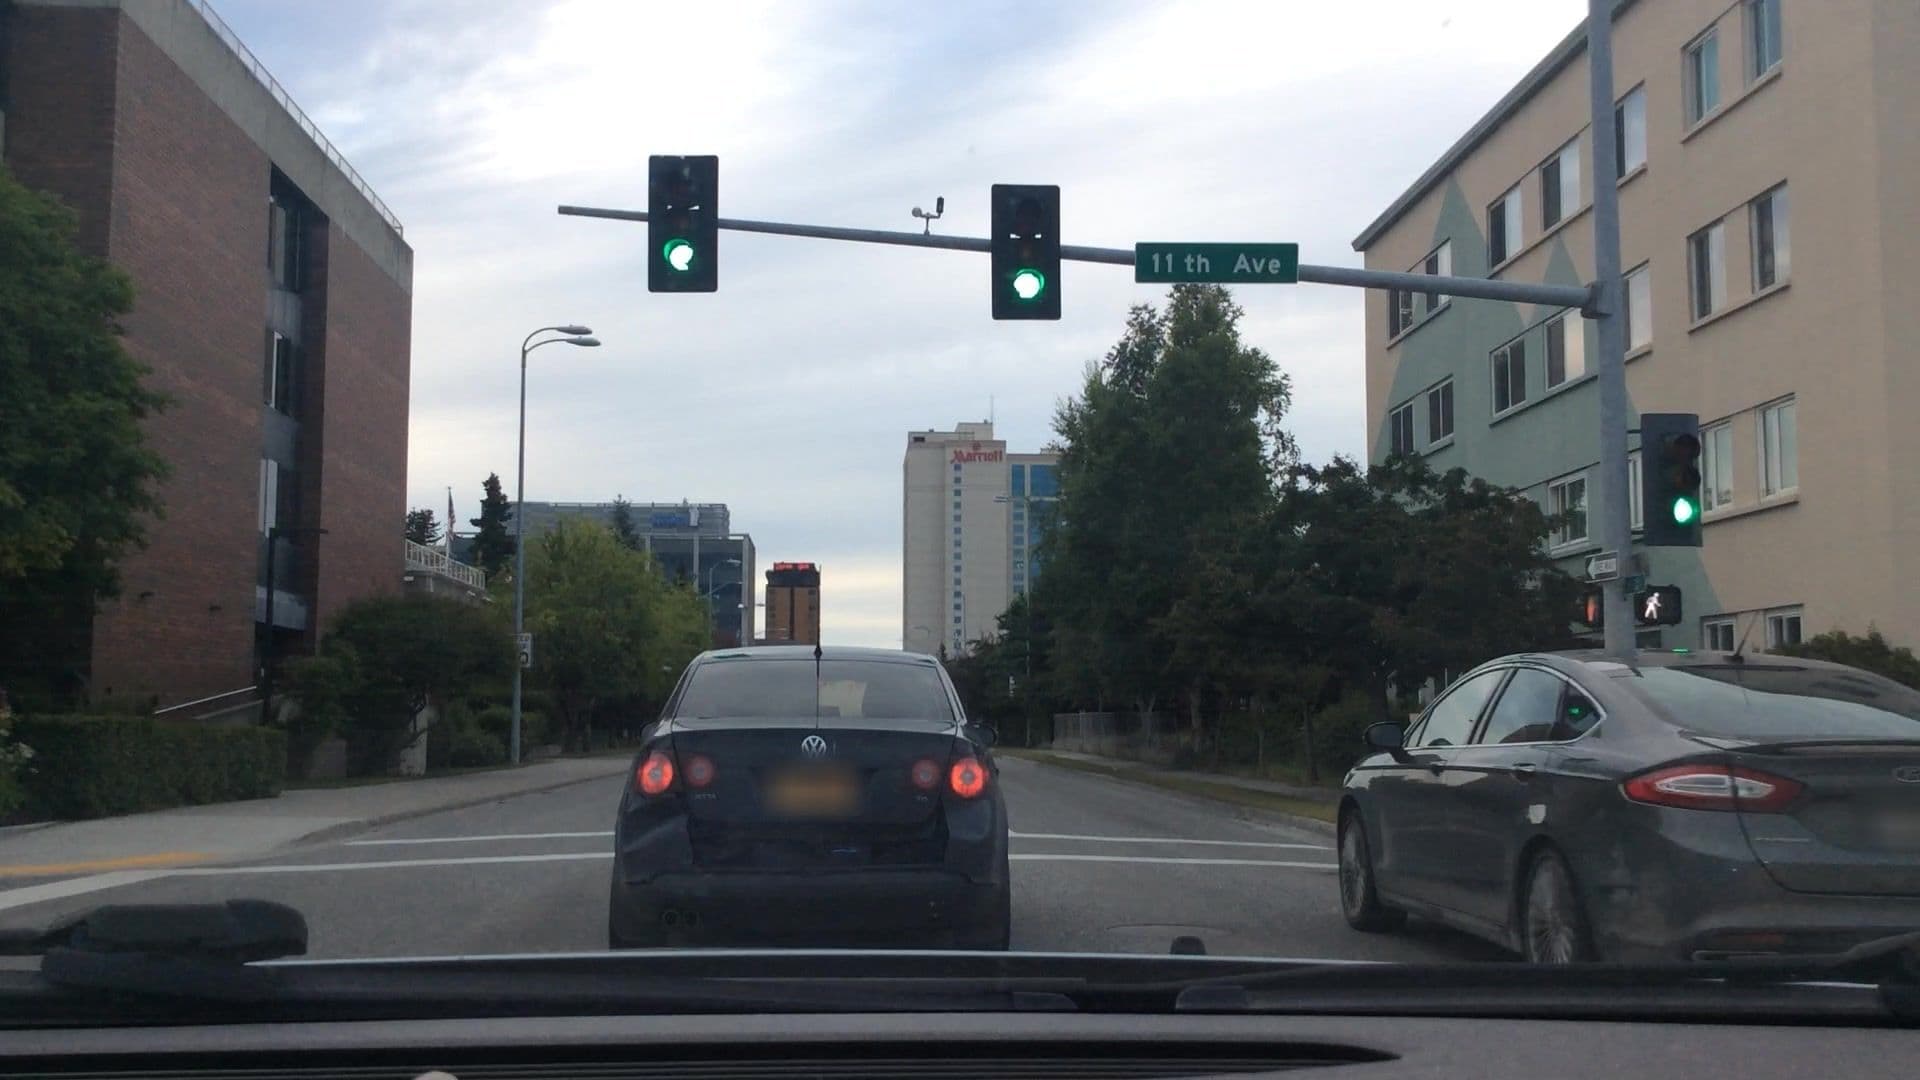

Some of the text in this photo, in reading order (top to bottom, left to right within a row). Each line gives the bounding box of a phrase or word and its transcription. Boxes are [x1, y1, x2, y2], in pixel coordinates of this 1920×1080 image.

[1151, 252, 1281, 273] 11 th Ave
[950, 449, 1003, 464] Marriott
